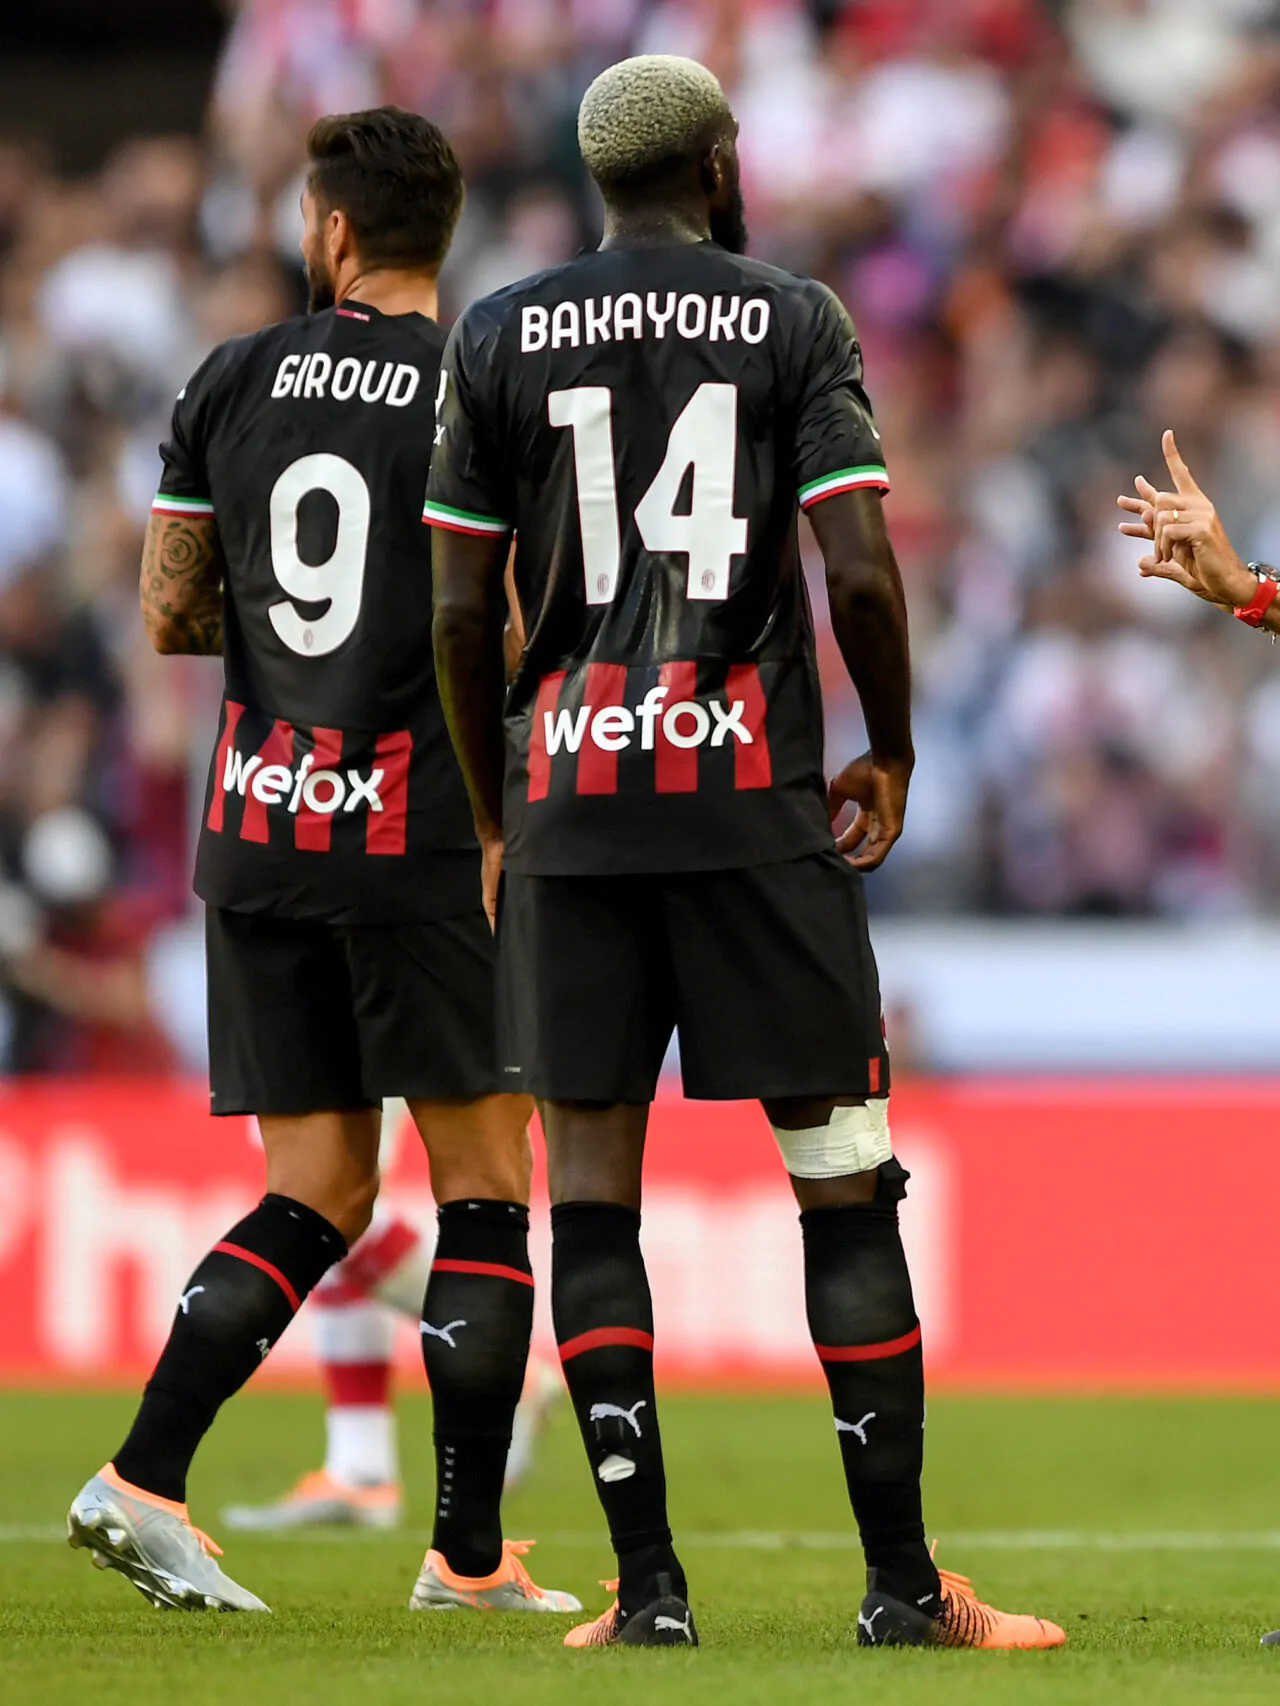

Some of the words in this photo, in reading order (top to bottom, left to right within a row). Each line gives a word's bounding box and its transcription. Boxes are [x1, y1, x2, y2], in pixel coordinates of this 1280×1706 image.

[520, 291, 771, 353] BAKAYOKO
[270, 352, 420, 407] GIROUD
[547, 382, 749, 605] 14
[268, 452, 371, 657] 9
[543, 685, 754, 756] wefox
[222, 745, 385, 814] wefox
